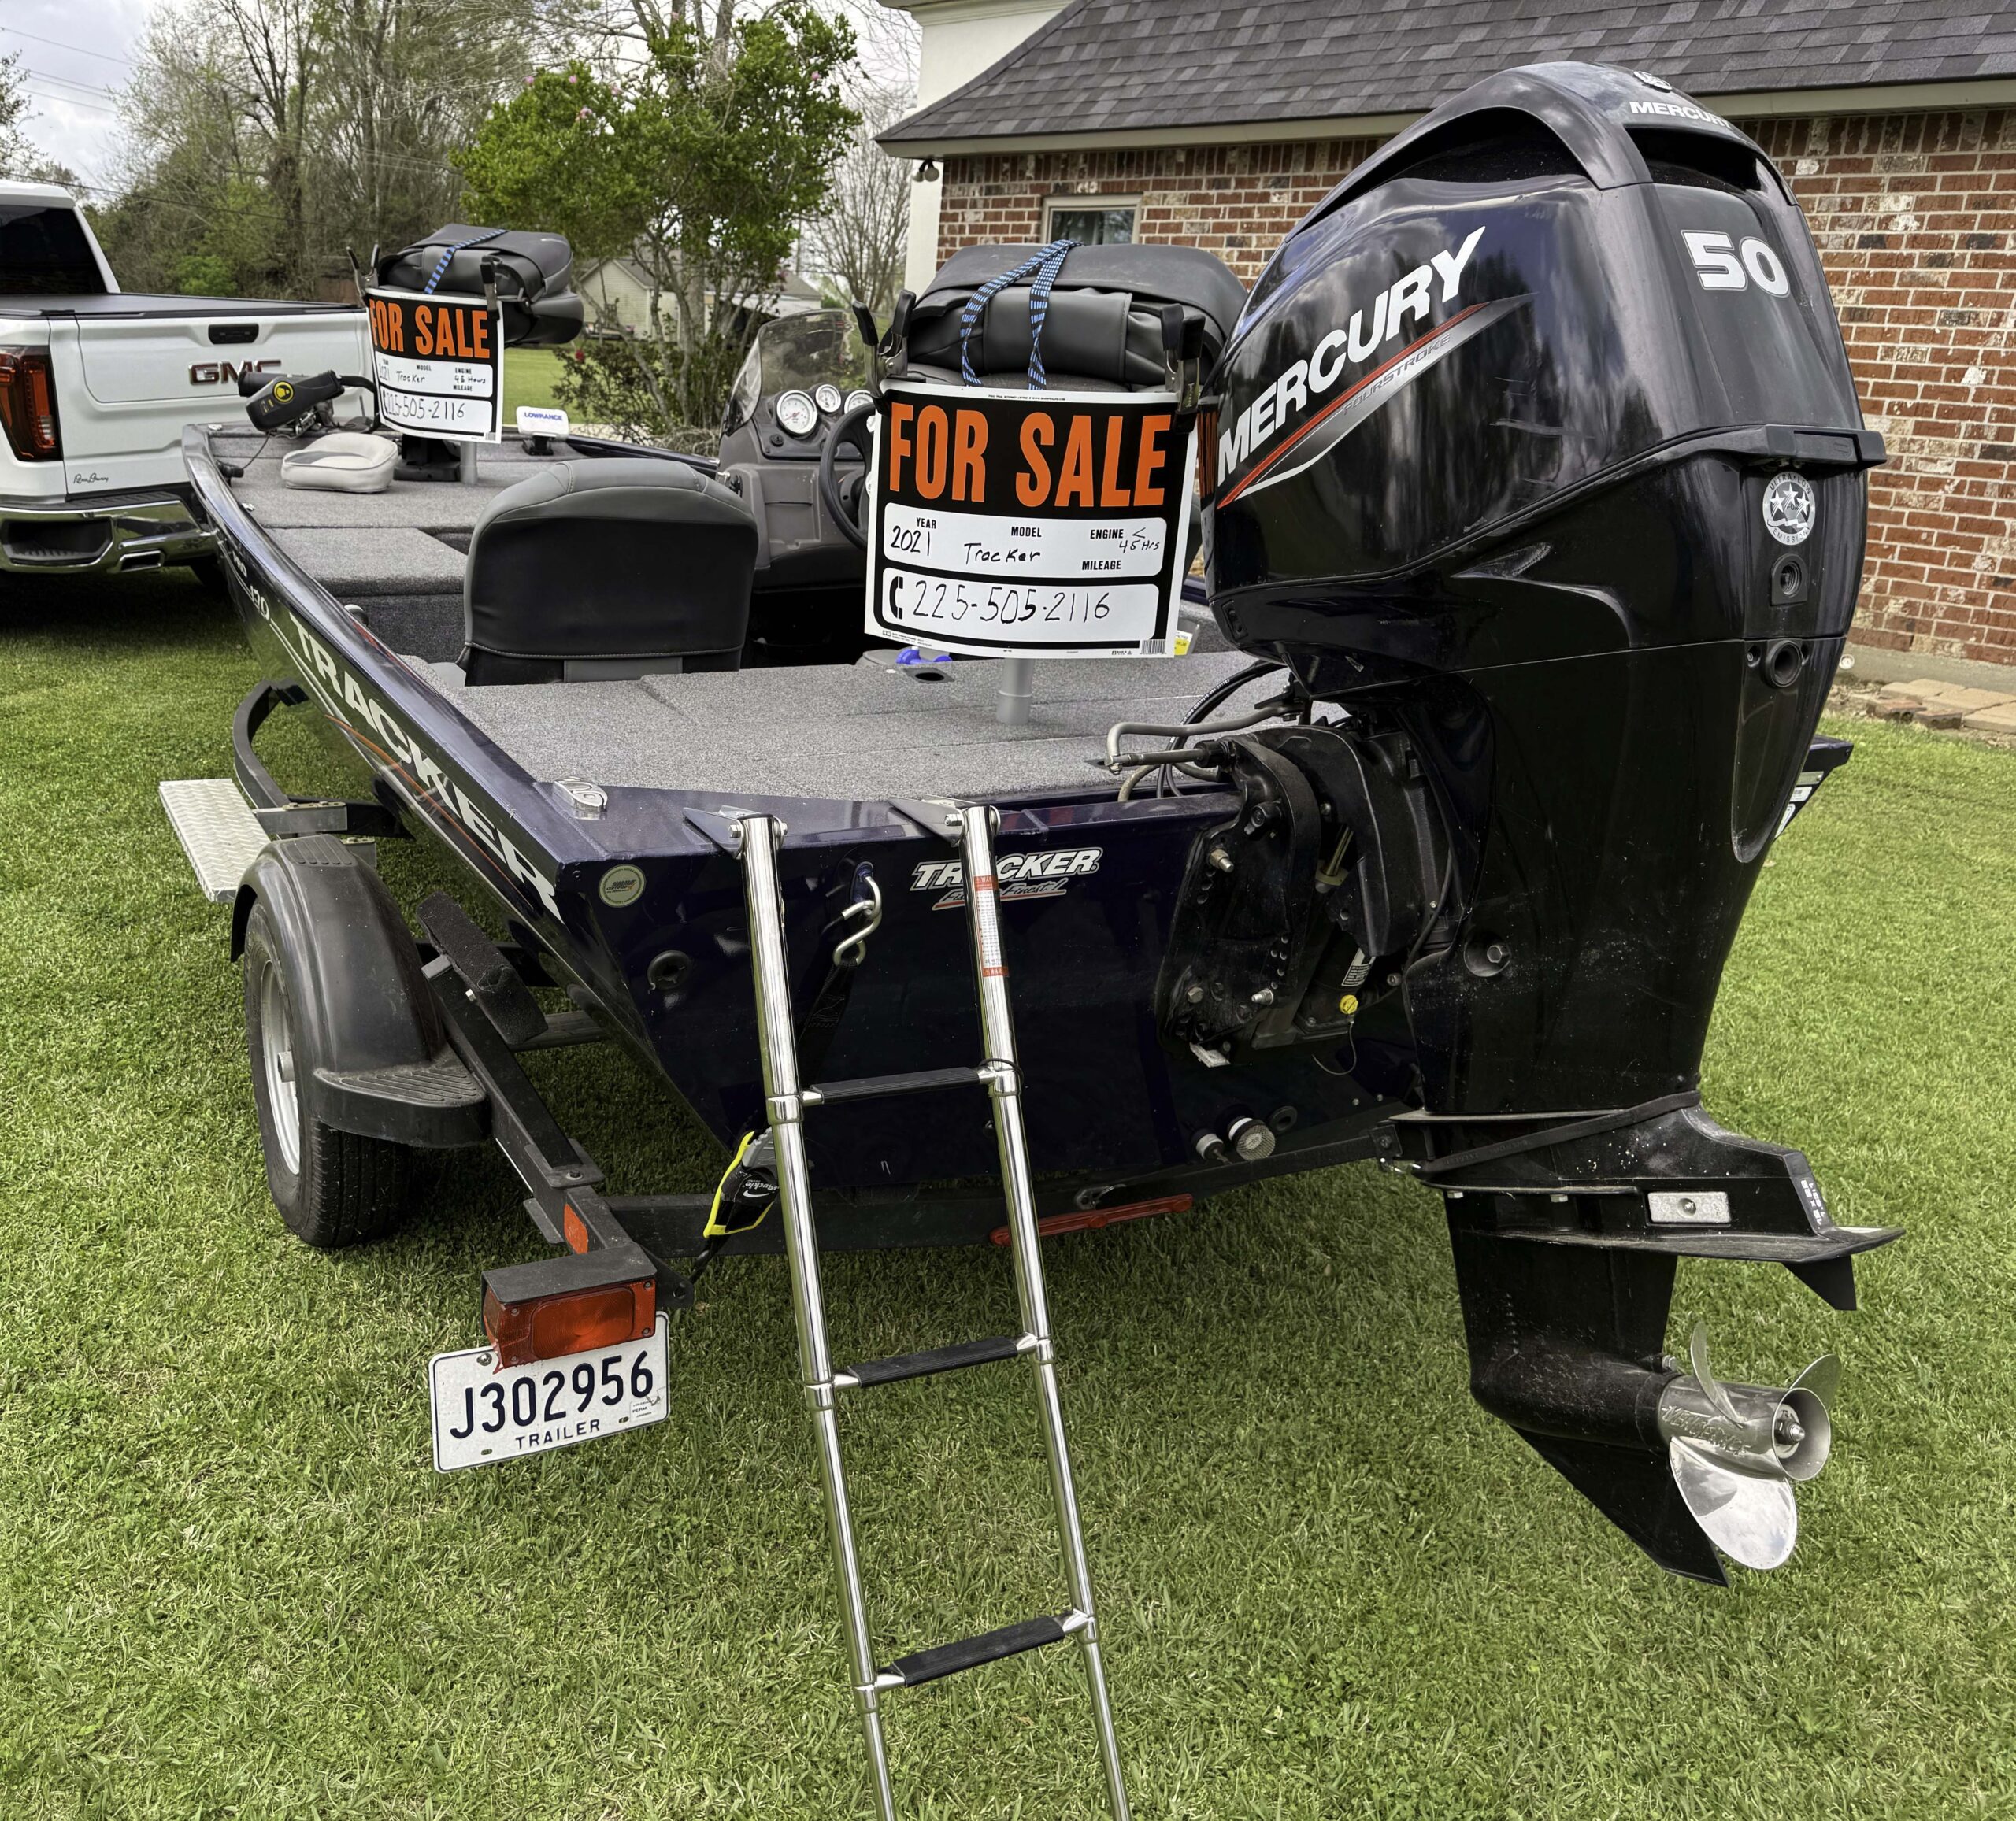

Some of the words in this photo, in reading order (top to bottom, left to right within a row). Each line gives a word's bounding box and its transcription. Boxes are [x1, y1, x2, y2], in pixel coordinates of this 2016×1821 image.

[1629, 101, 1731, 128] MERCURY
[1681, 229, 1791, 298] 50
[369, 298, 404, 352] FOR
[415, 305, 490, 359] SALE
[1217, 226, 1487, 487] MERCURY
[1342, 332, 1451, 416] FOURSTROKE
[524, 411, 563, 421] LOWRANCE
[889, 402, 988, 502] FOR
[1015, 412, 1172, 508] SALE
[890, 525, 931, 557] 2021
[916, 516, 936, 530] YEAR
[1010, 526, 1042, 539] MODEL
[1089, 527, 1124, 540] ENGINE
[1118, 539, 1137, 553] 45
[1141, 540, 1160, 551] Hrs
[1082, 560, 1122, 572] MILEAGE
[913, 579, 1110, 624] 225-505-2116
[288, 611, 567, 926] TRACKER
[911, 848, 1101, 889] TRCKER
[449, 1349, 654, 1439] J302956
[515, 1419, 600, 1449] TRAILER
